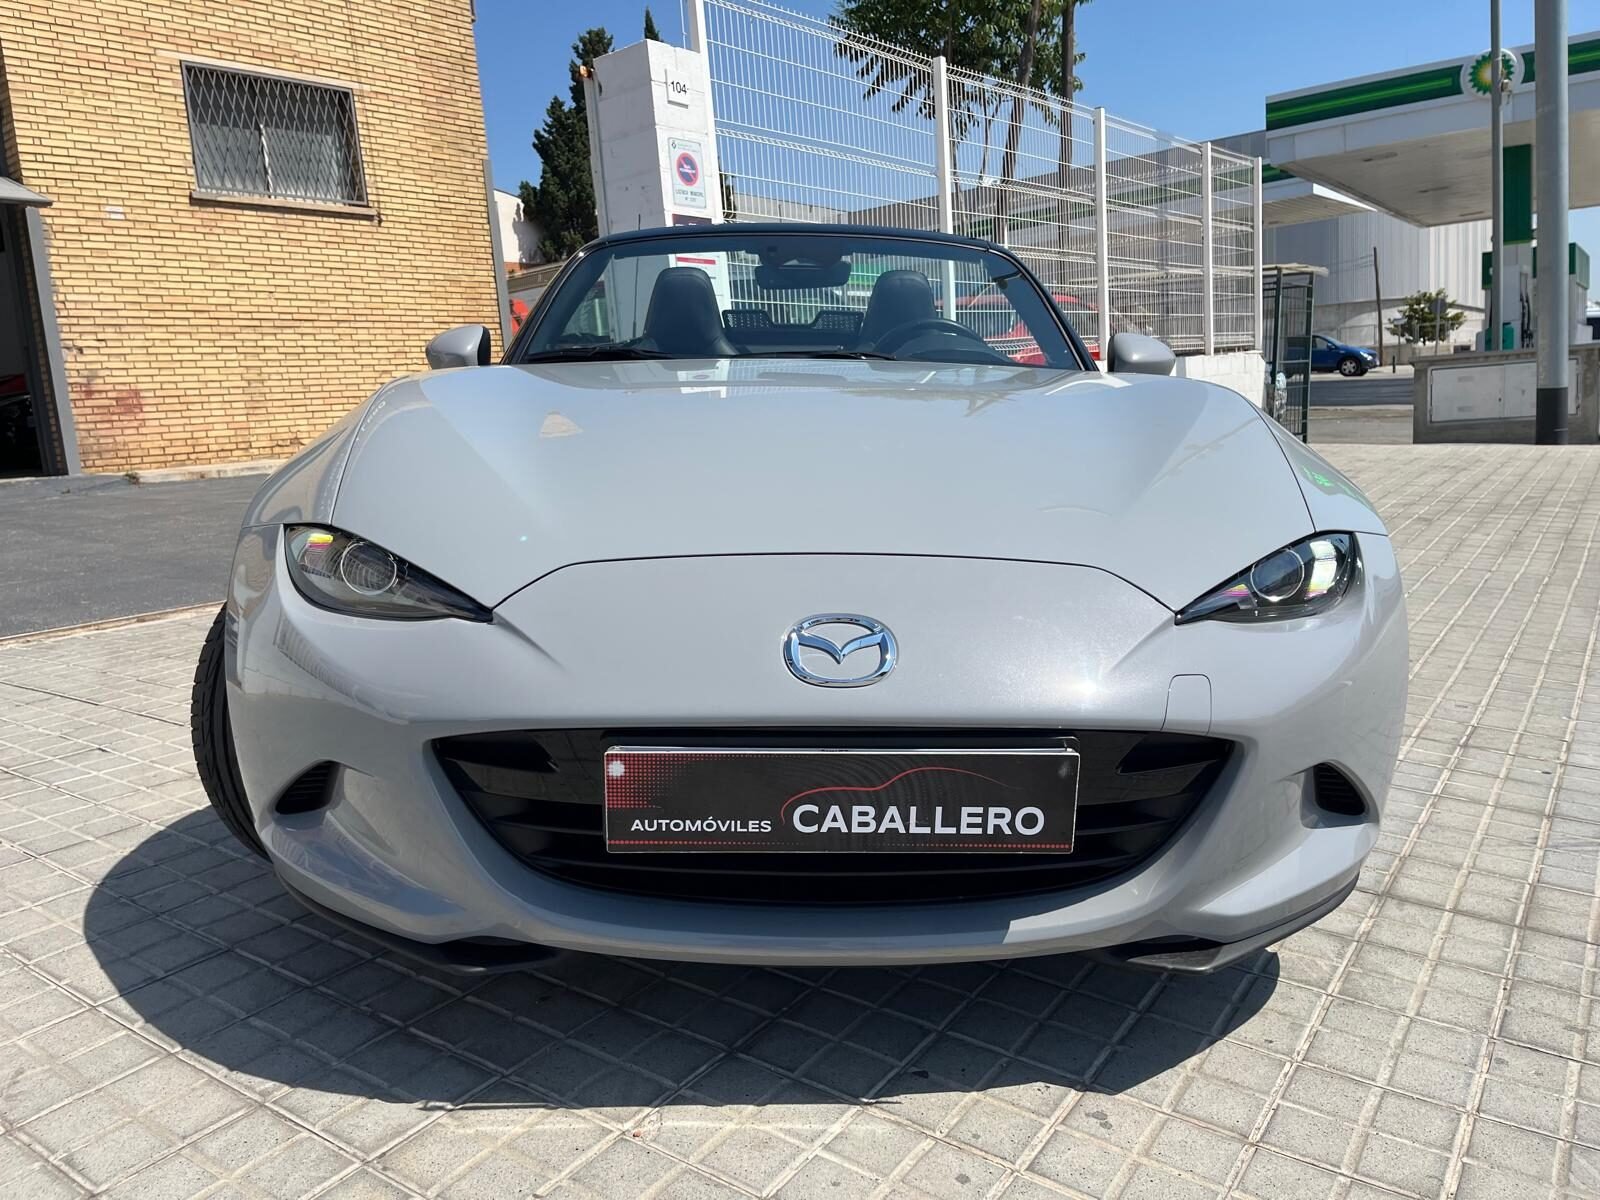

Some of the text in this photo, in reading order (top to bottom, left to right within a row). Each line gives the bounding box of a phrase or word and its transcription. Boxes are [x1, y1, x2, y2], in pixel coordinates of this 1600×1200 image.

[670, 80, 687, 96] 104
[630, 804, 1045, 836] AUTOMÓVILES CABALLERO
